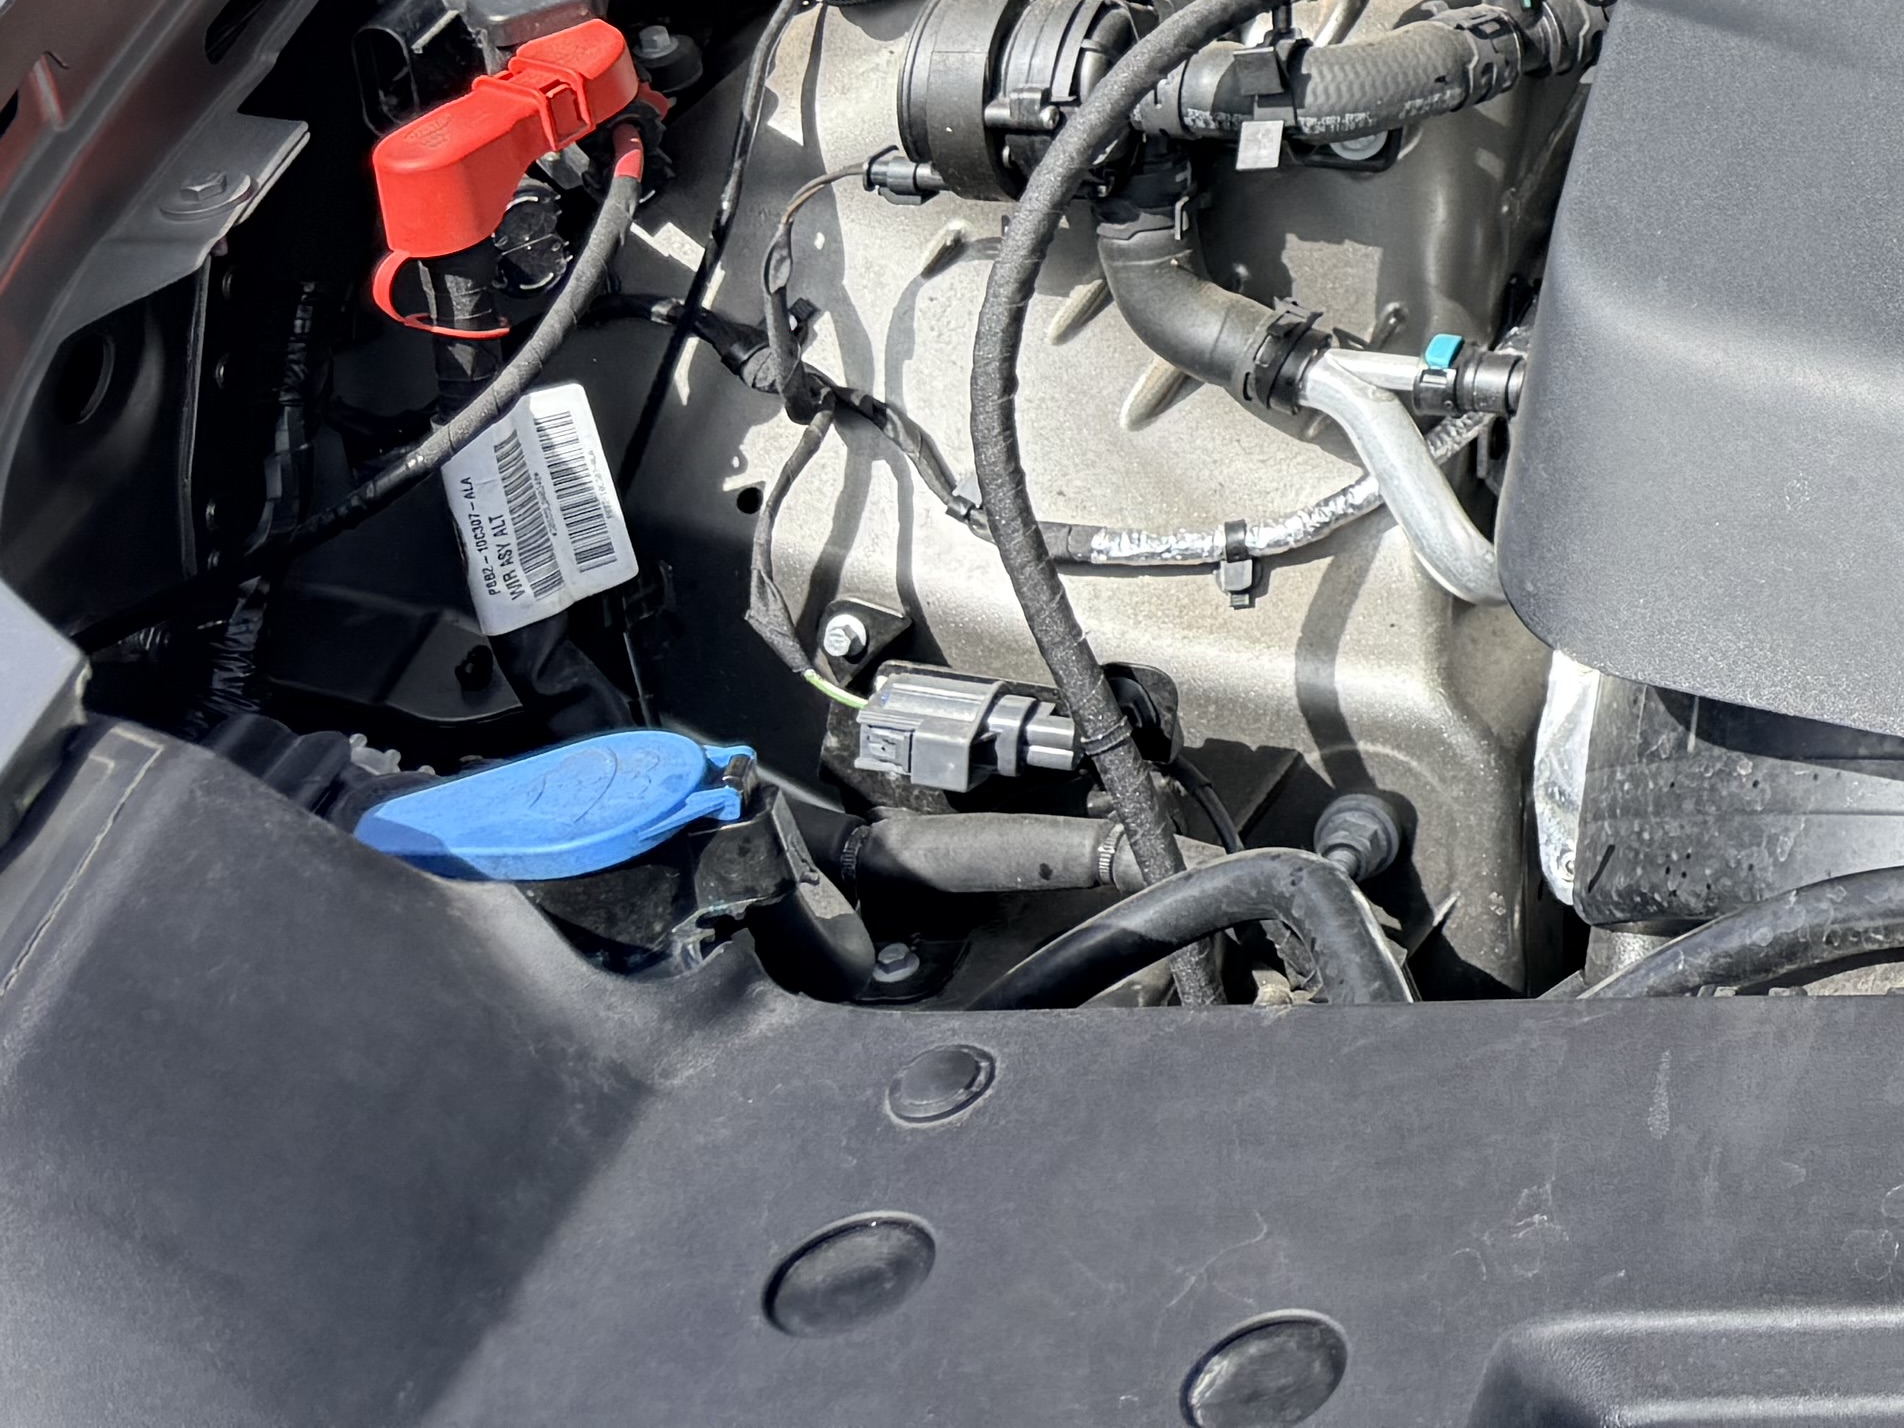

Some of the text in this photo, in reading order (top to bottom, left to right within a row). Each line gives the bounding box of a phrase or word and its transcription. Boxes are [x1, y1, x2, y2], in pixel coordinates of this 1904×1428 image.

[488, 514, 526, 601] WIR ASY ALT
